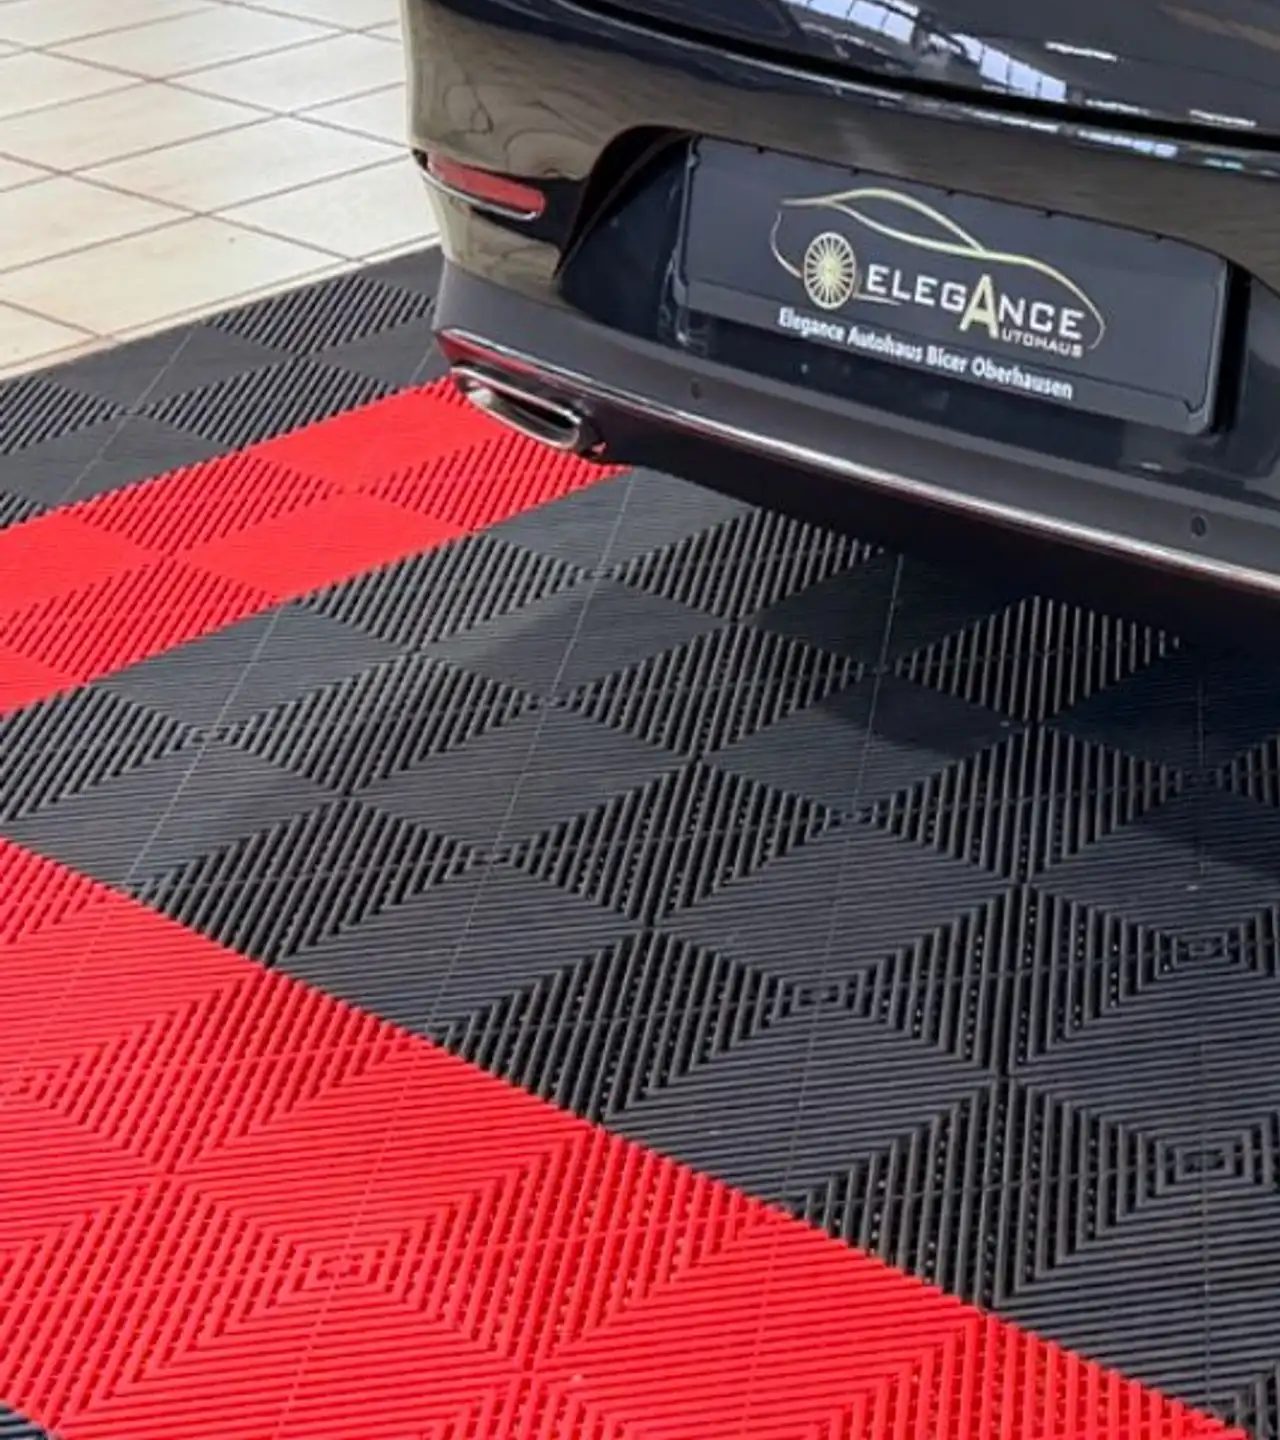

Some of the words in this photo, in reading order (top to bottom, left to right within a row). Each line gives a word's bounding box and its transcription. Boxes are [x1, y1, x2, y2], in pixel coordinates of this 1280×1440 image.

[867, 264, 1085, 340] ELEGANCE
[778, 307, 844, 340] Elegance
[849, 326, 922, 362] Autohaus
[972, 356, 1074, 400] Oberhausen
